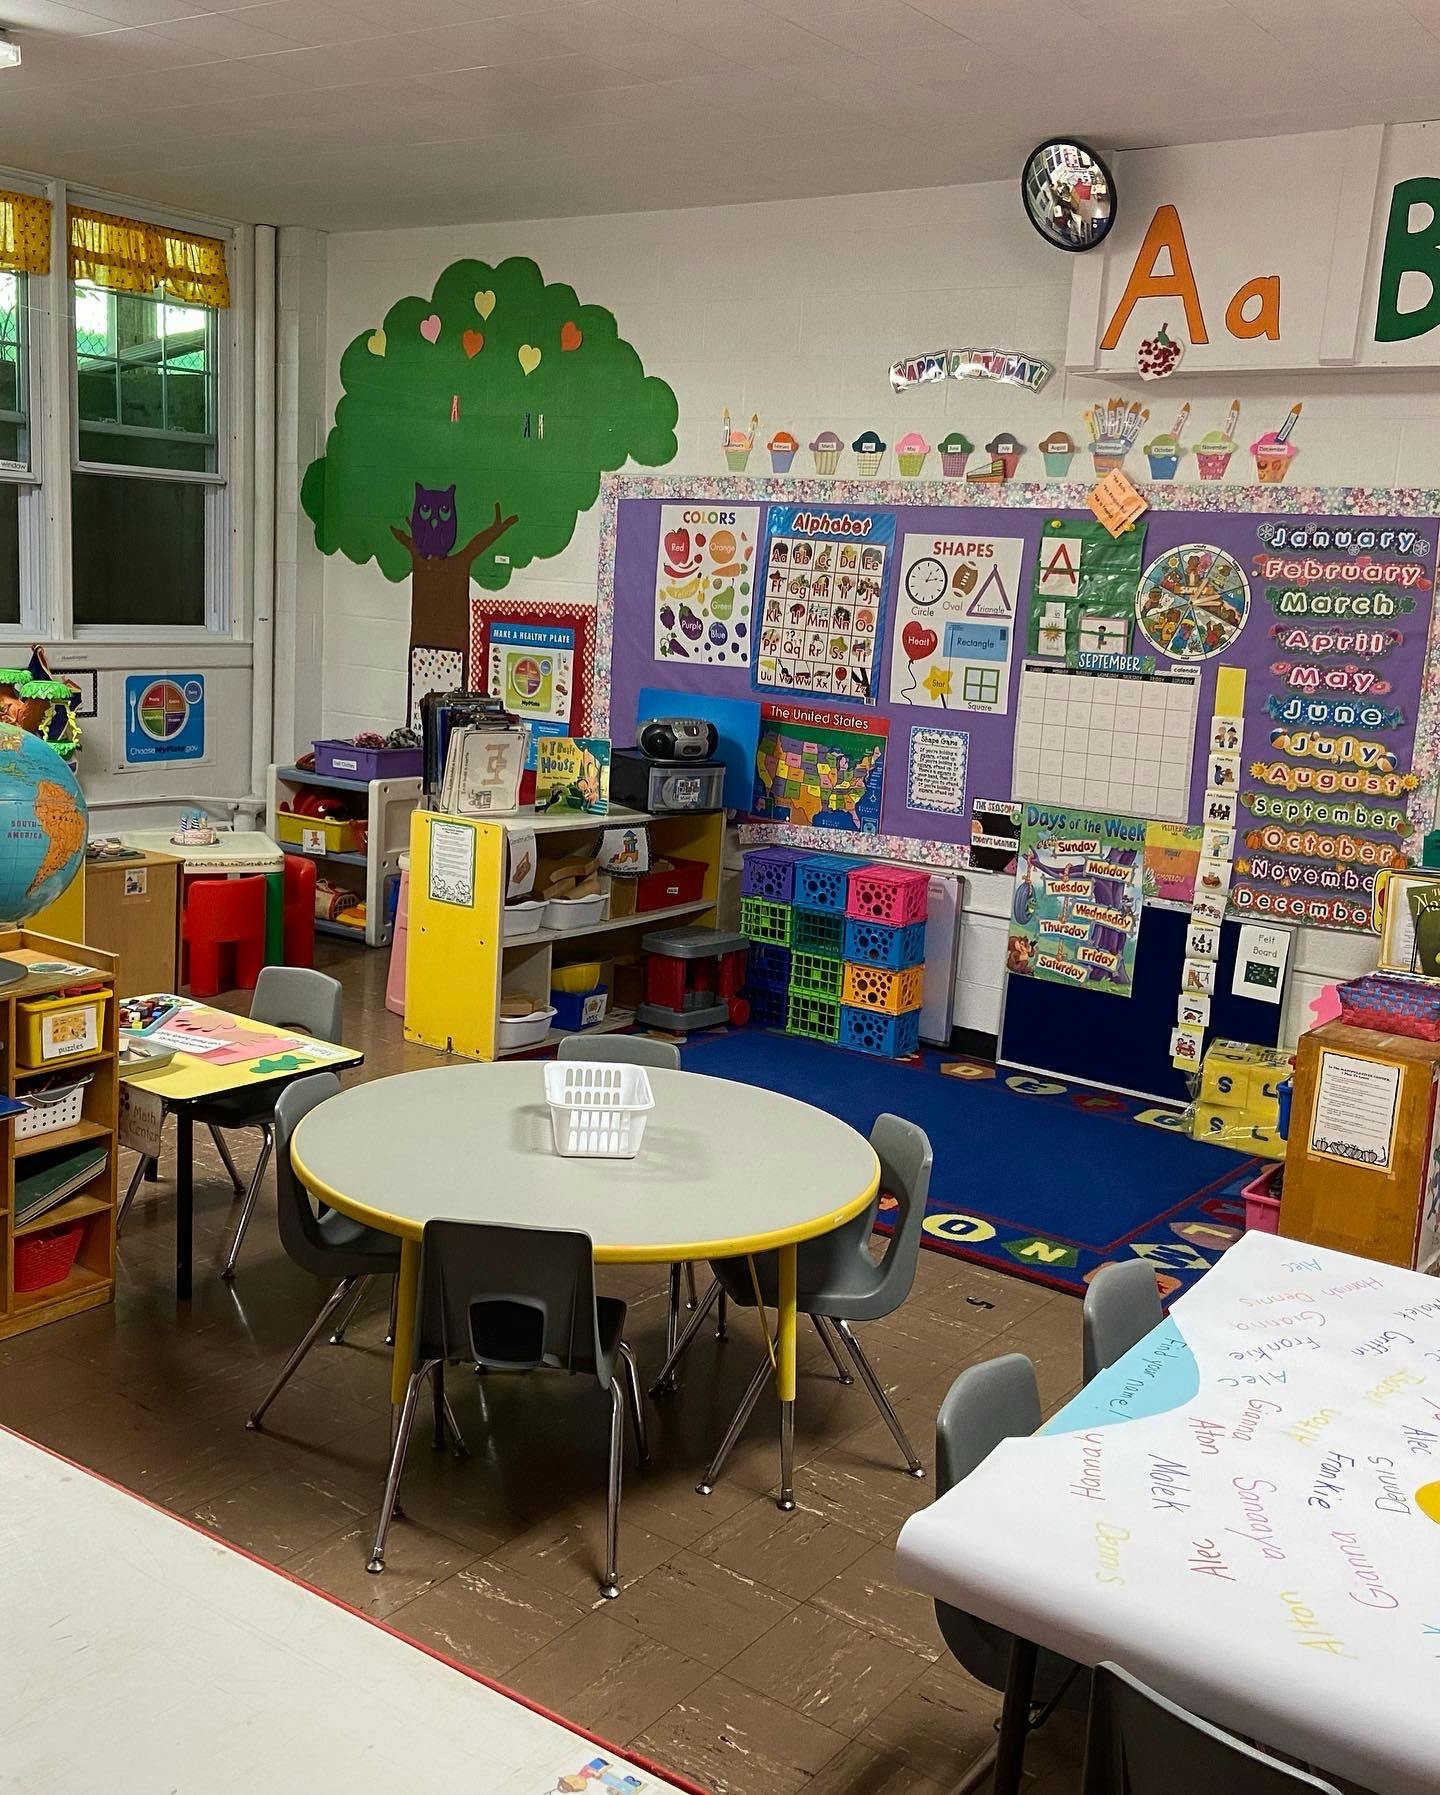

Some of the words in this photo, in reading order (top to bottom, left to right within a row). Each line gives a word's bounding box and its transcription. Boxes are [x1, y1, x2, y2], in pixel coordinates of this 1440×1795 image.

[683, 511, 736, 525] COLORS
[793, 513, 872, 536] Alphabet
[671, 543, 685, 552] Red
[933, 541, 994, 558] SHAPES
[1272, 528, 1416, 552] January
[1042, 543, 1076, 584] A
[1266, 560, 1421, 586] February
[911, 606, 934, 617] Circle
[942, 601, 963, 611] Oval
[977, 604, 1005, 615] Triangle
[1280, 592, 1394, 615] March
[681, 620, 702, 631] Purple
[711, 630, 726, 639] Blue
[493, 629, 511, 638] MAKE
[513, 631, 517, 639] A
[520, 632, 546, 642] HEALTHY
[549, 634, 570, 643] PLATE
[908, 636, 930, 646] Heart
[957, 637, 994, 649] Rectangle
[1285, 630, 1383, 652] April
[1078, 653, 1141, 671] SEPTEMBER
[932, 679, 946, 688] Star
[1289, 667, 1375, 692] May
[771, 705, 790, 719] The
[793, 709, 829, 724] United
[833, 714, 869, 730] States
[968, 703, 992, 712] Square
[1283, 699, 1382, 725] June
[921, 736, 939, 747] Shape
[940, 738, 958, 747] Game
[1293, 738, 1378, 762] July
[541, 756, 574, 773] HOUSE
[1271, 766, 1400, 791] August
[976, 801, 986, 811] THE
[1255, 798, 1399, 827] September
[11, 820, 37, 828] SOUTH
[1027, 805, 1067, 831] Days
[1069, 818, 1082, 830] of
[1084, 819, 1101, 833] the
[1105, 821, 1146, 842] Week
[7, 832, 42, 840] AMERICA
[1058, 841, 1097, 853] Sunday
[1267, 831, 1393, 863] October
[1088, 863, 1130, 879] Monday
[1252, 859, 1374, 892] Novembe
[1048, 881, 1090, 894] Tuesday
[1076, 904, 1131, 929] Wednesday
[1238, 890, 1368, 924] Decembe
[1041, 920, 1088, 939] Thursday
[1258, 934, 1276, 944] Felt
[1082, 949, 1116, 967] Friday
[1253, 946, 1277, 958] Board
[1039, 956, 1085, 979] Saturday
[58, 1042, 84, 1055] puzzles
[1218, 1076, 1233, 1093] S
[134, 1105, 156, 1125] Math
[1210, 1116, 1224, 1134] S
[129, 1120, 159, 1142] Center
[947, 1218, 978, 1235] O
[1020, 1242, 1068, 1262] N
[1284, 1259, 1323, 1273] Alec
[1239, 1288, 1316, 1308] Dennis
[1321, 1276, 1384, 1304] Hannah
[1228, 1309, 1326, 1331] Gianna
[1154, 1338, 1187, 1358] Find
[1228, 1335, 1321, 1361] Frankie
[1351, 1330, 1415, 1356] Griffin
[1142, 1358, 1163, 1378] your
[1217, 1370, 1287, 1387] Alec
[1109, 1379, 1144, 1419] name!
[1232, 1397, 1283, 1441] Gianna
[1402, 1424, 1439, 1455] Alec
[1070, 1432, 1106, 1501] Hannah
[1148, 1453, 1191, 1513] Malek
[1307, 1449, 1355, 1511] Frankie
[1368, 1456, 1412, 1515] Dennis
[1188, 1538, 1236, 1581] Alec
[1331, 1529, 1400, 1610] Gianna
